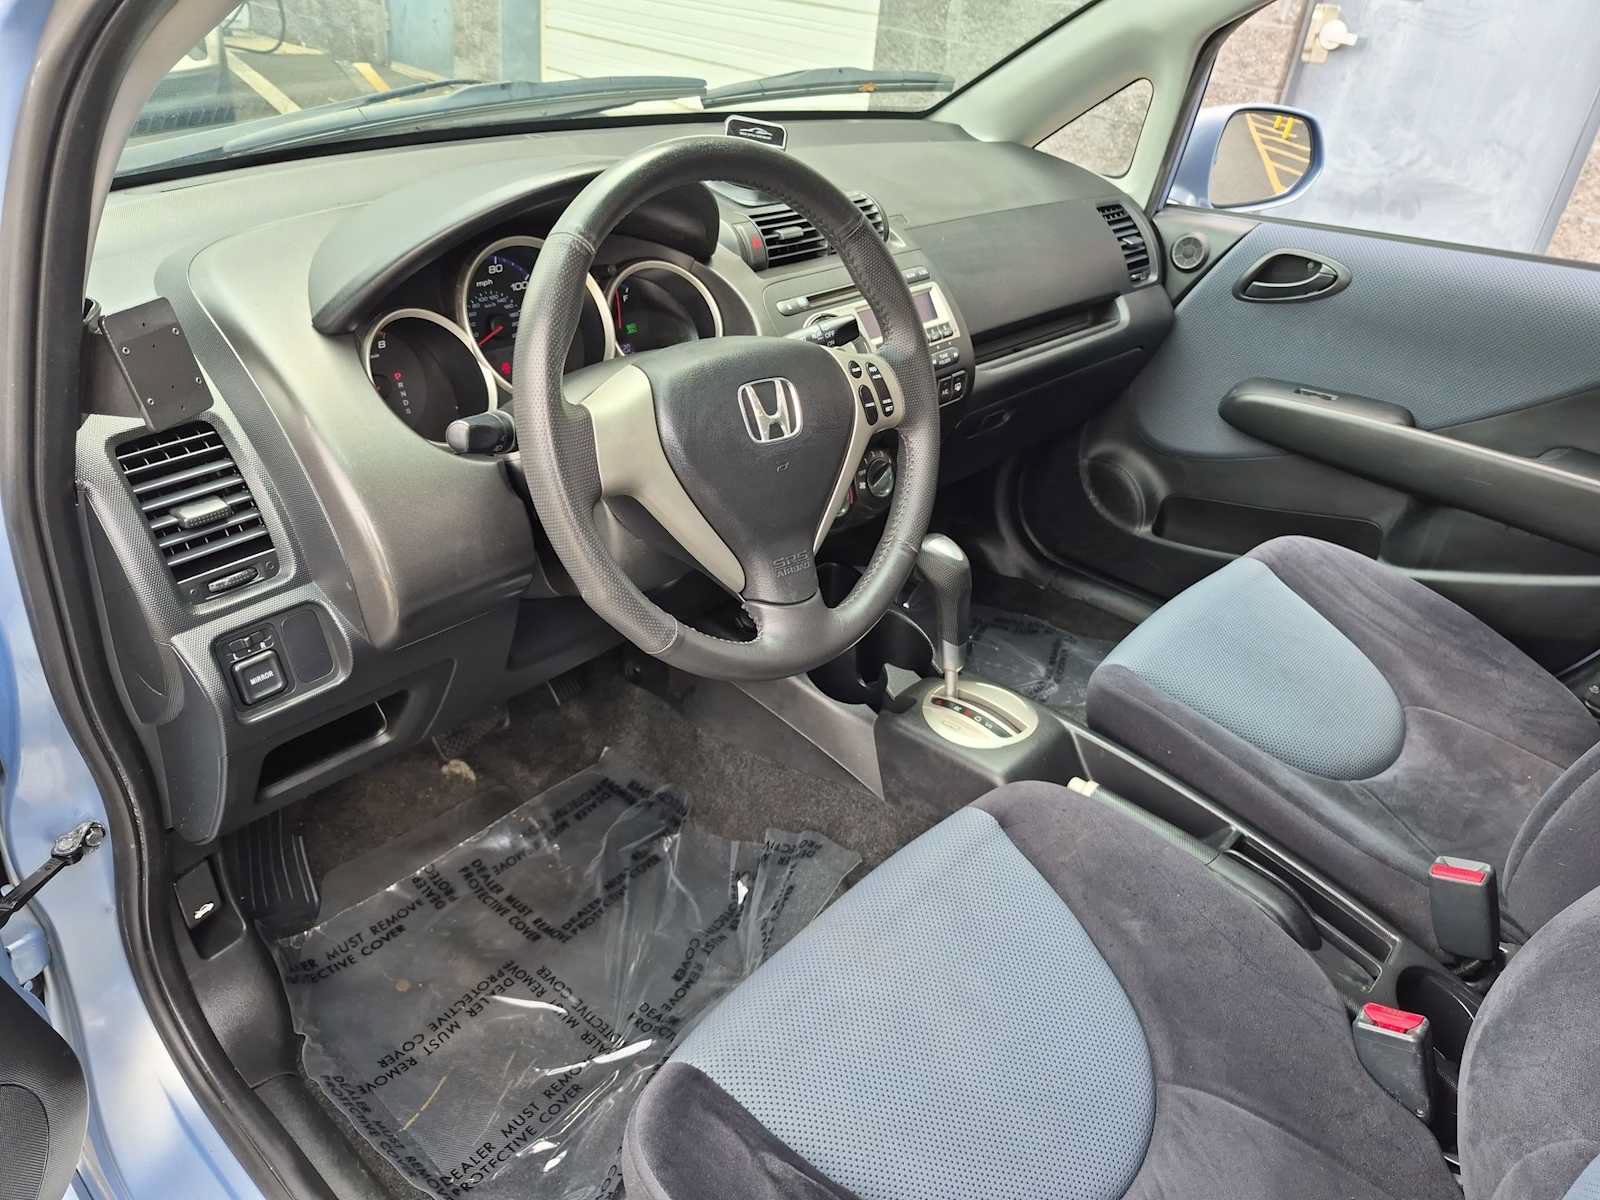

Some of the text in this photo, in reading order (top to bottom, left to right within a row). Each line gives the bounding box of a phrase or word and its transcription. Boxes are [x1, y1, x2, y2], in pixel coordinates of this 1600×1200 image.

[476, 279, 493, 287] mph
[488, 264, 503, 274] 80
[510, 281, 529, 291] 100
[378, 340, 386, 349] 8
[250, 669, 274, 685] MIRROR
[457, 866, 543, 942] PROTECTIVE COVER
[471, 858, 573, 944] DEALER MUST REMOVE
[326, 932, 364, 961] MUST
[369, 899, 425, 936] REMOVE
[360, 924, 406, 957] COVER
[502, 959, 548, 998] REMOVE
[536, 964, 573, 1000] COVER
[357, 976, 515, 1096] DEALER MUST REMOVE
[377, 967, 507, 1069] PROTECTIVE COVER
[332, 1075, 372, 1114] DEALER
[373, 1120, 406, 1150] MUST
[440, 1142, 497, 1187] DEALER
[501, 1101, 541, 1139] MUST
[543, 1053, 594, 1099] REMO
[539, 1083, 584, 1125] COVER
